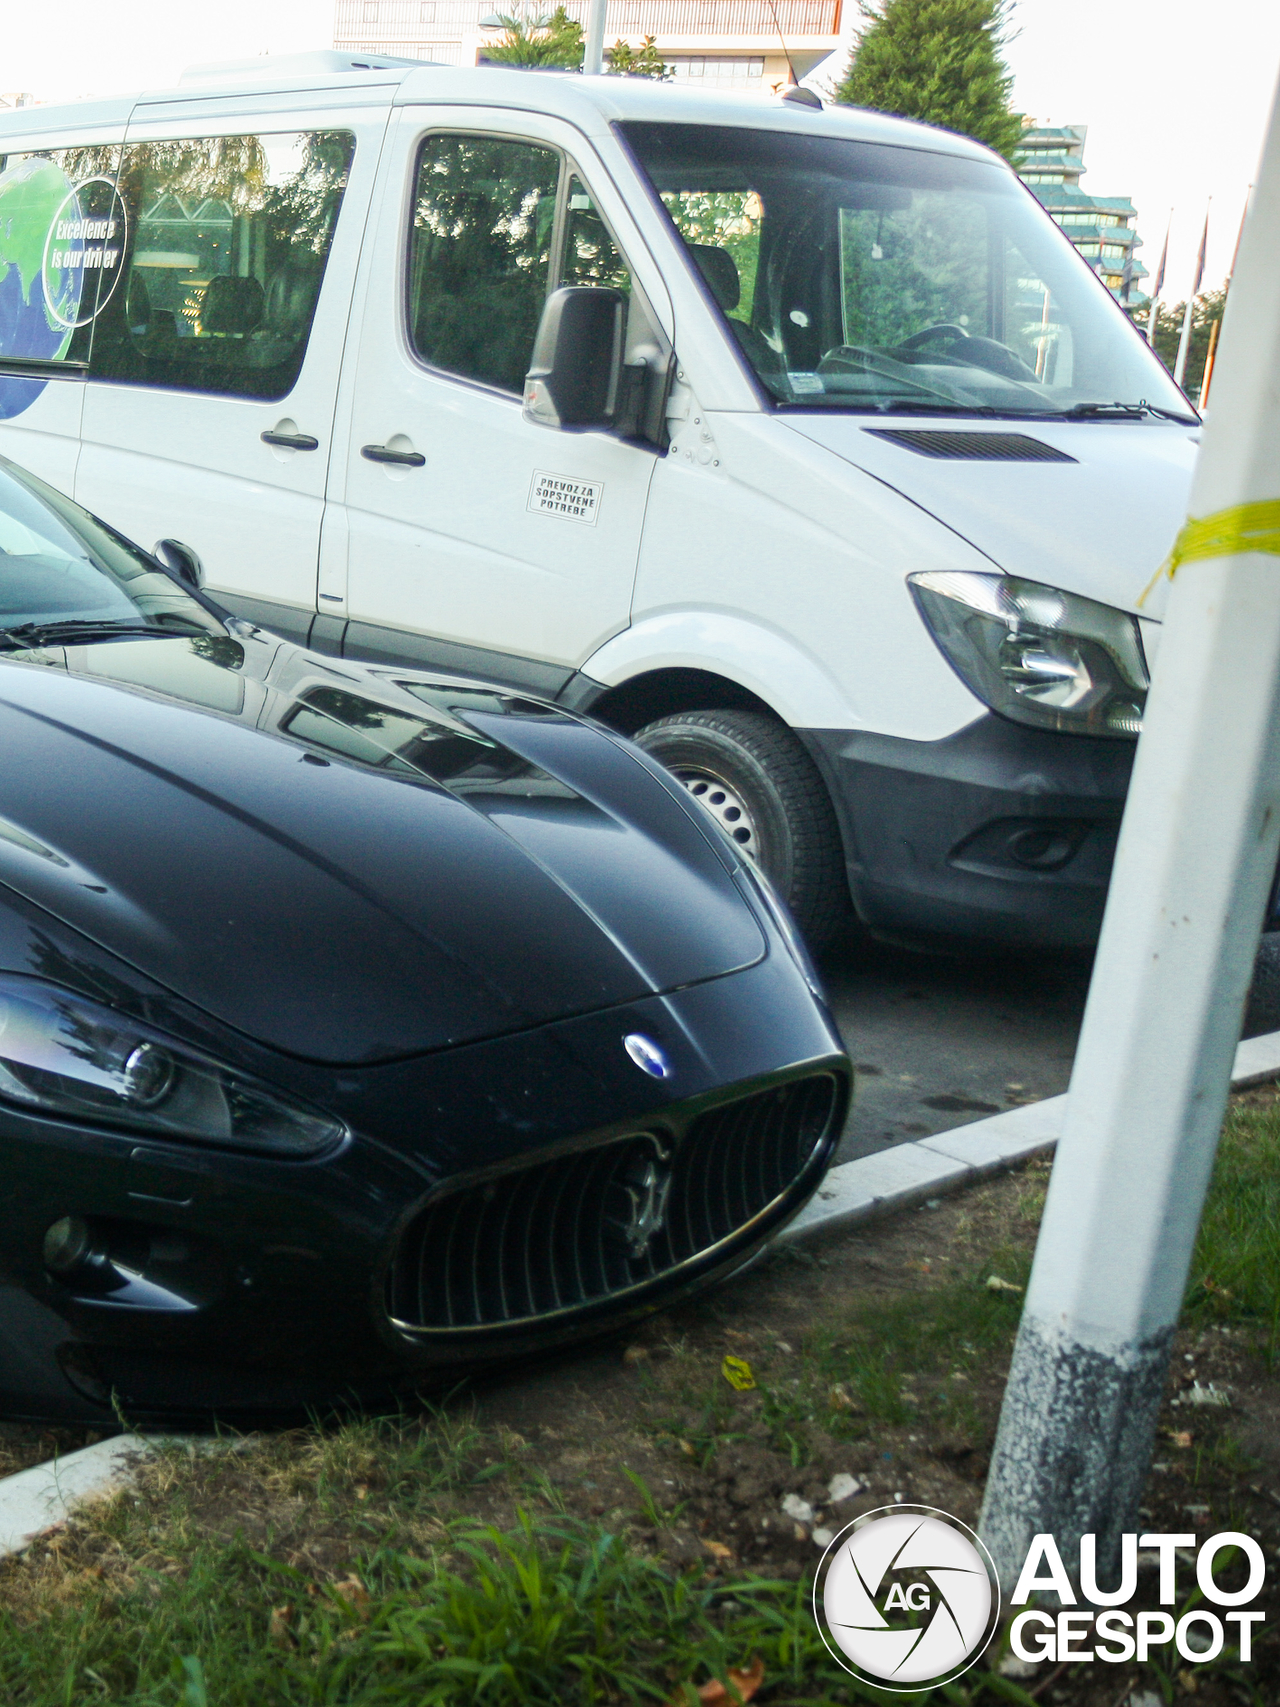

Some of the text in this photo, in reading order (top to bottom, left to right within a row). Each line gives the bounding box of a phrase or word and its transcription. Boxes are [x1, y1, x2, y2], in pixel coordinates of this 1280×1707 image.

[56, 219, 115, 239] Excellence
[51, 248, 62, 268] is
[63, 250, 82, 268] our
[540, 478, 593, 496] PREVOZ ZA
[535, 487, 595, 508] SOPSTVENE
[540, 499, 586, 516] POTREBE
